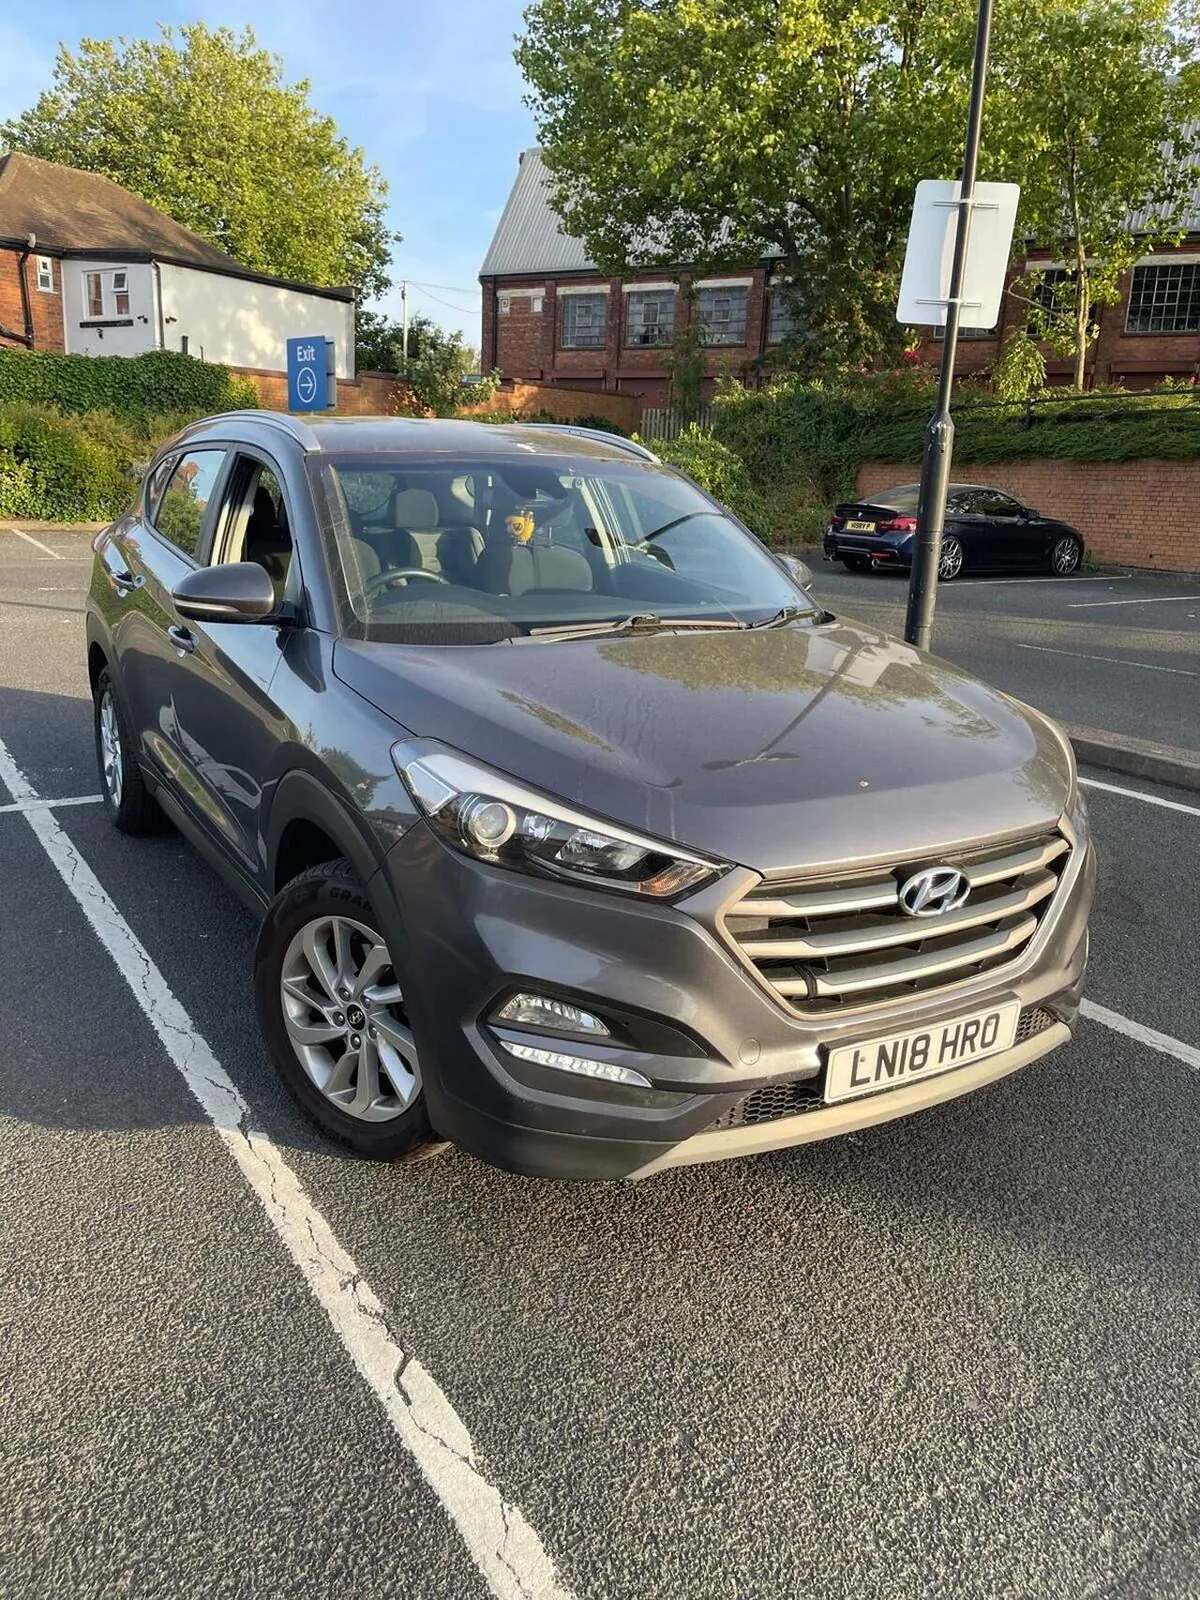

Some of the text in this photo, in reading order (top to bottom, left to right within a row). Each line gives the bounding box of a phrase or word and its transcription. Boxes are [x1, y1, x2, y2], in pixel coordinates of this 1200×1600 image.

[296, 345, 316, 361] Exit
[850, 1002, 1001, 1088] LN18 HRO
